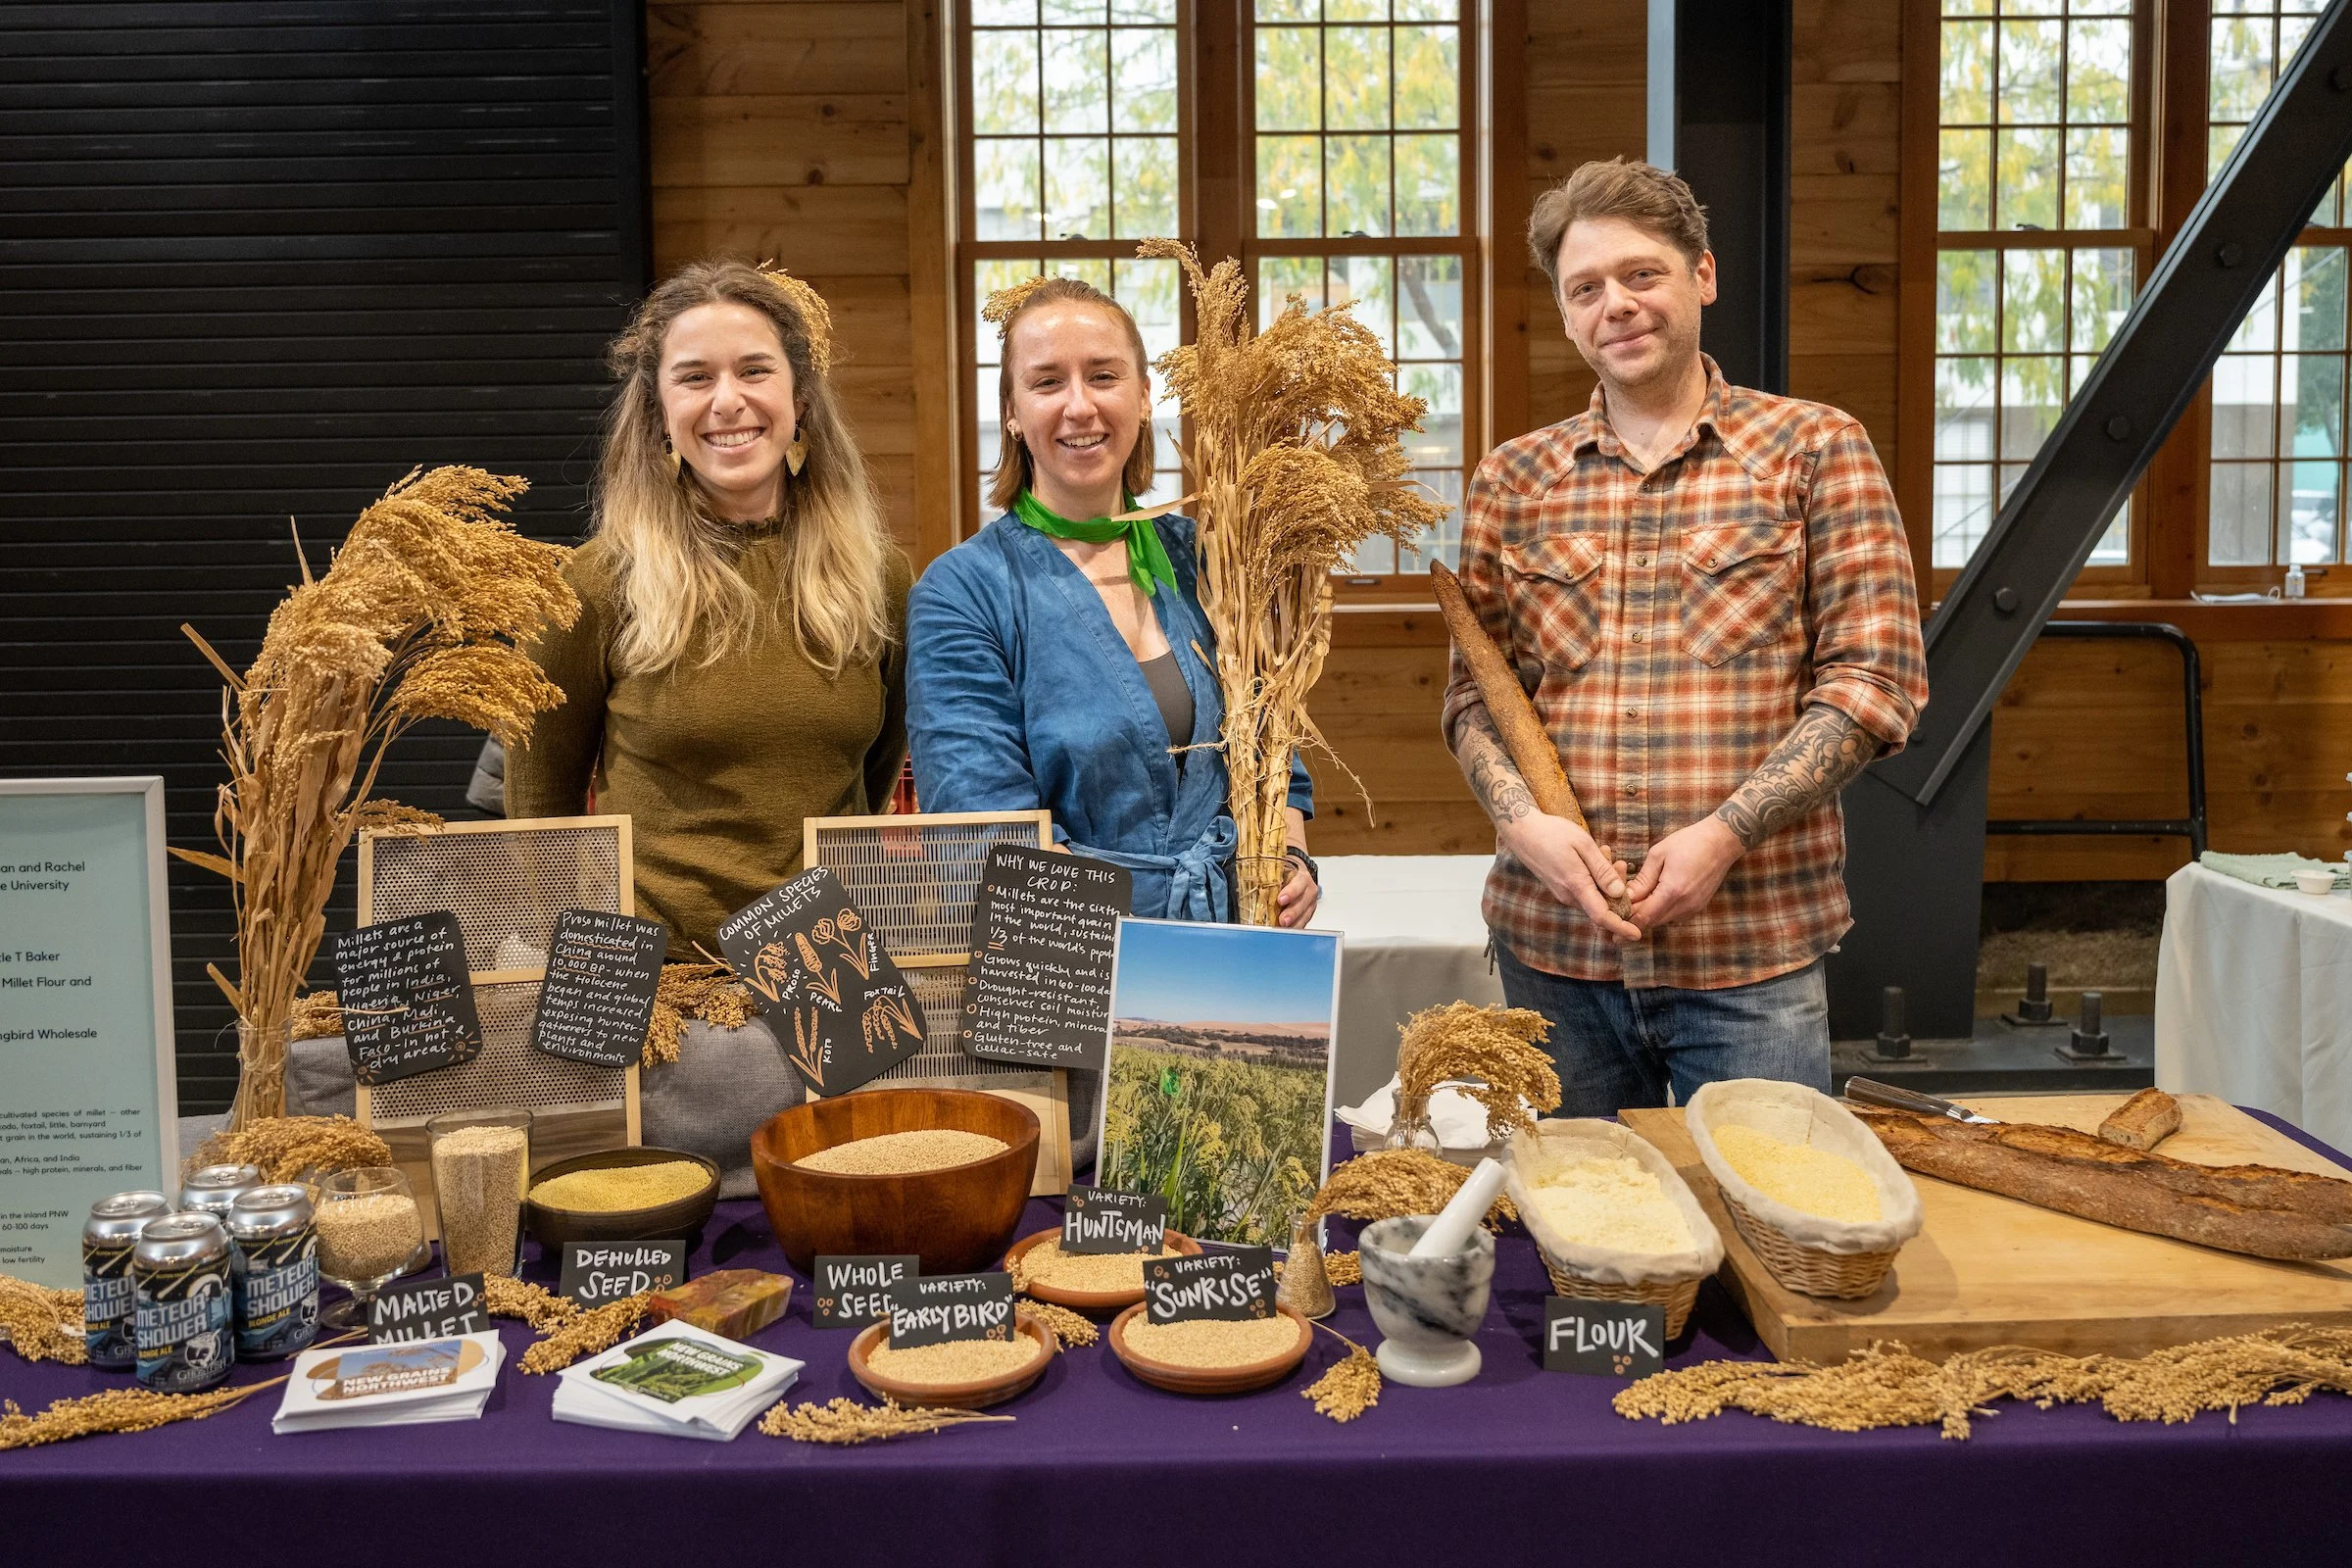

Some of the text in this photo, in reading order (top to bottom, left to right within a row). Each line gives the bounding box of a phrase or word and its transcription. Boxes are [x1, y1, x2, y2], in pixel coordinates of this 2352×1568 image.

[19, 861, 84, 872] and Rachel
[996, 854, 1115, 883] WHY WE LOVE THIS
[11, 881, 69, 891] University
[1027, 876, 1078, 892] CROP:
[720, 865, 828, 941] COMMON SPECIES
[744, 885, 821, 940] OF MILLETS
[996, 885, 1120, 916] Millets are the sixth
[563, 911, 659, 936] Proso millet was
[991, 900, 1112, 931] most important grain
[1004, 914, 1022, 927] the
[1030, 920, 1067, 938] world,
[335, 927, 447, 959] major source of
[338, 921, 423, 949] Millets are a
[560, 928, 653, 951] domesticated in
[990, 926, 1086, 954] 1/3 of the world's
[16, 952, 60, 961] T Baker
[338, 942, 454, 973] energy protein
[556, 944, 638, 965] China around
[984, 953, 1110, 980] Grows quickly and is
[342, 958, 440, 988] for millions of
[549, 967, 628, 990] the Holocene
[552, 957, 649, 980] 10,000 when
[981, 965, 1096, 994] harvested in 60-100
[2, 976, 91, 988] Millet Flour and
[342, 973, 451, 1002] people in India,
[415, 985, 461, 1003] Niger,
[979, 979, 1101, 1009] Drought-resistant,
[547, 982, 651, 1008] began and global
[977, 994, 1110, 1018] conserves soil moistur
[347, 1004, 446, 1031] China, Mali,
[542, 1008, 593, 1027] exposing
[546, 995, 647, 1023] temps increased,
[979, 1005, 1108, 1034] High protein, minera
[37, 1028, 97, 1039] Wholesale
[354, 1015, 456, 1044] and Burkina
[425, 1030, 449, 1041] hot
[538, 1020, 640, 1043] gatherers to new
[976, 1019, 1049, 1036] and fiber
[538, 1030, 606, 1052] plants and
[974, 1031, 1083, 1053] Gluten-free and
[369, 1054, 399, 1069] dry
[71, 1120, 106, 1129] barnyard
[6, 1134, 26, 1143] grain
[1088, 1191, 1147, 1208] VARIETY:
[246, 1254, 315, 1298] METEOR
[826, 1261, 904, 1290] WHOLE
[1175, 1255, 1241, 1274] VARIETY:
[247, 1274, 315, 1318] SHOWER
[578, 1270, 652, 1299] SEED
[918, 1278, 987, 1295] VARIETY:
[137, 1292, 206, 1328] METEOR
[277, 1307, 291, 1318] ALE
[372, 1281, 474, 1326] MALTED
[137, 1313, 207, 1349] SHOWER
[1548, 1315, 1660, 1359] FLOUR
[669, 1342, 697, 1356] NEW
[343, 1367, 451, 1386] NEW GRAINS
[343, 1374, 448, 1394] NORTHWEST
